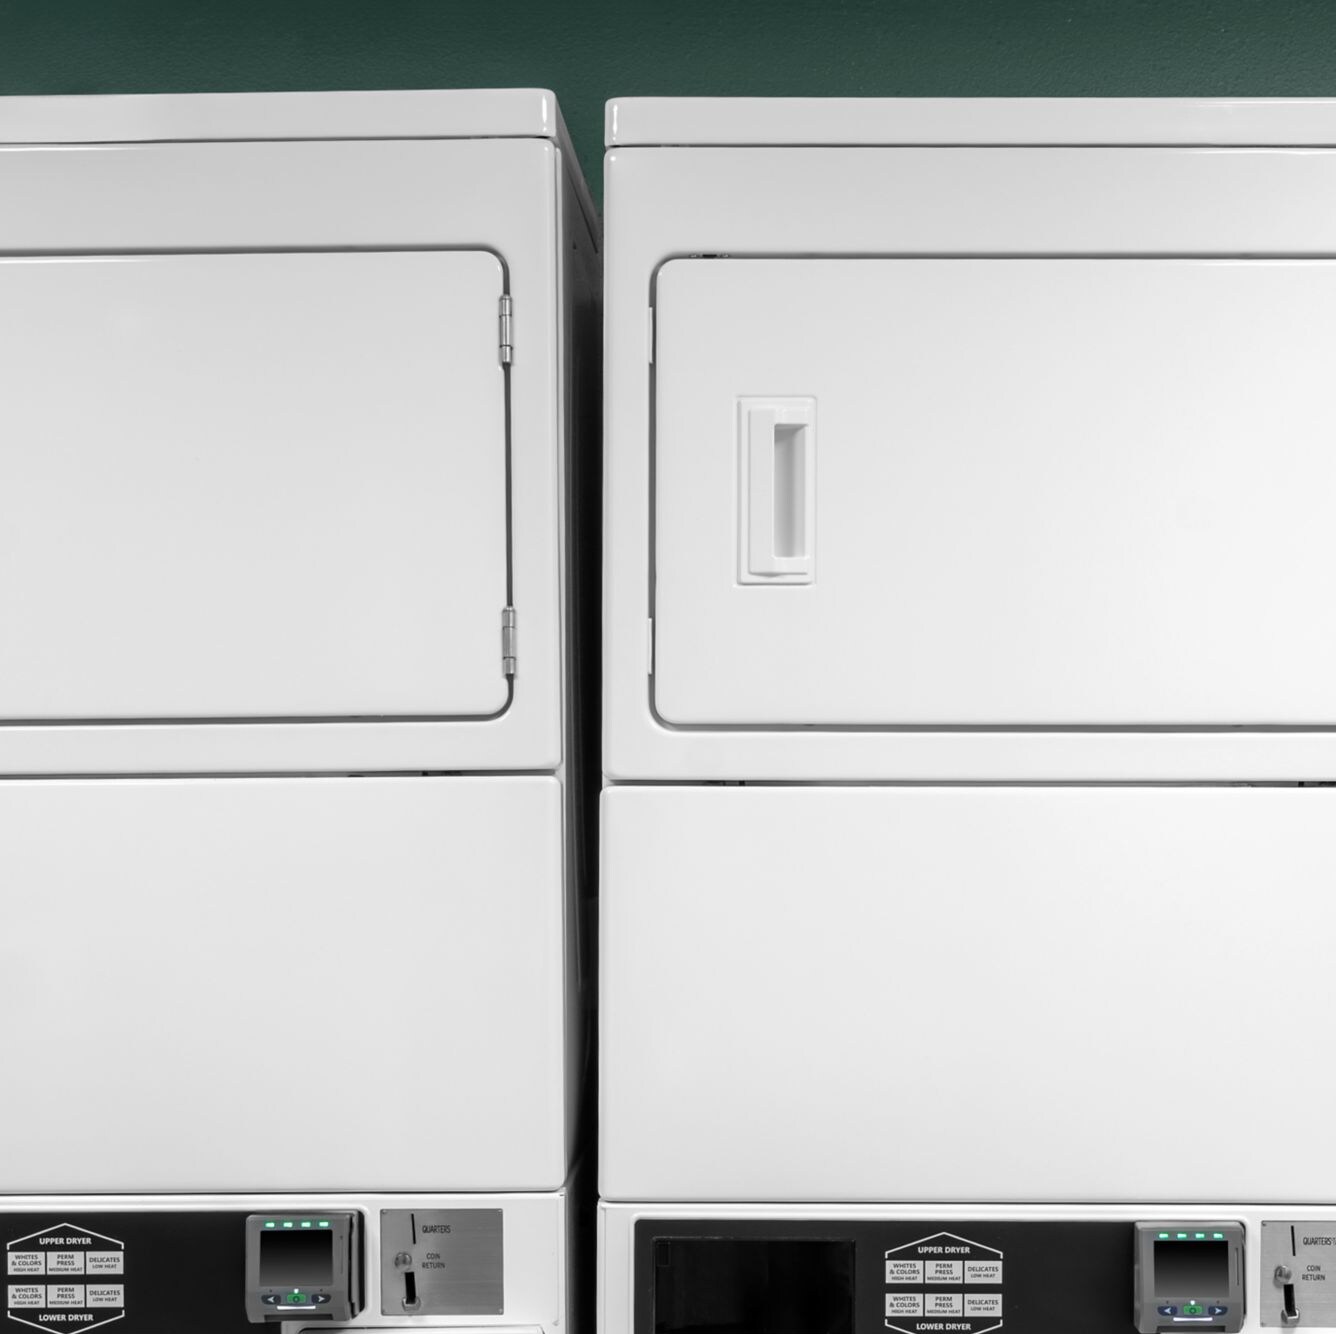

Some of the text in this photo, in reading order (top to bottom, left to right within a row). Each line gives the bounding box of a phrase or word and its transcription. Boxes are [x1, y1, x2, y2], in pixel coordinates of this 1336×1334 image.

[422, 1225, 451, 1234] QUARTERS
[39, 1237, 92, 1245] UPPER DRYER
[1303, 1237, 1332, 1246] QUARTERS
[918, 1246, 970, 1254] UPPER DRYER
